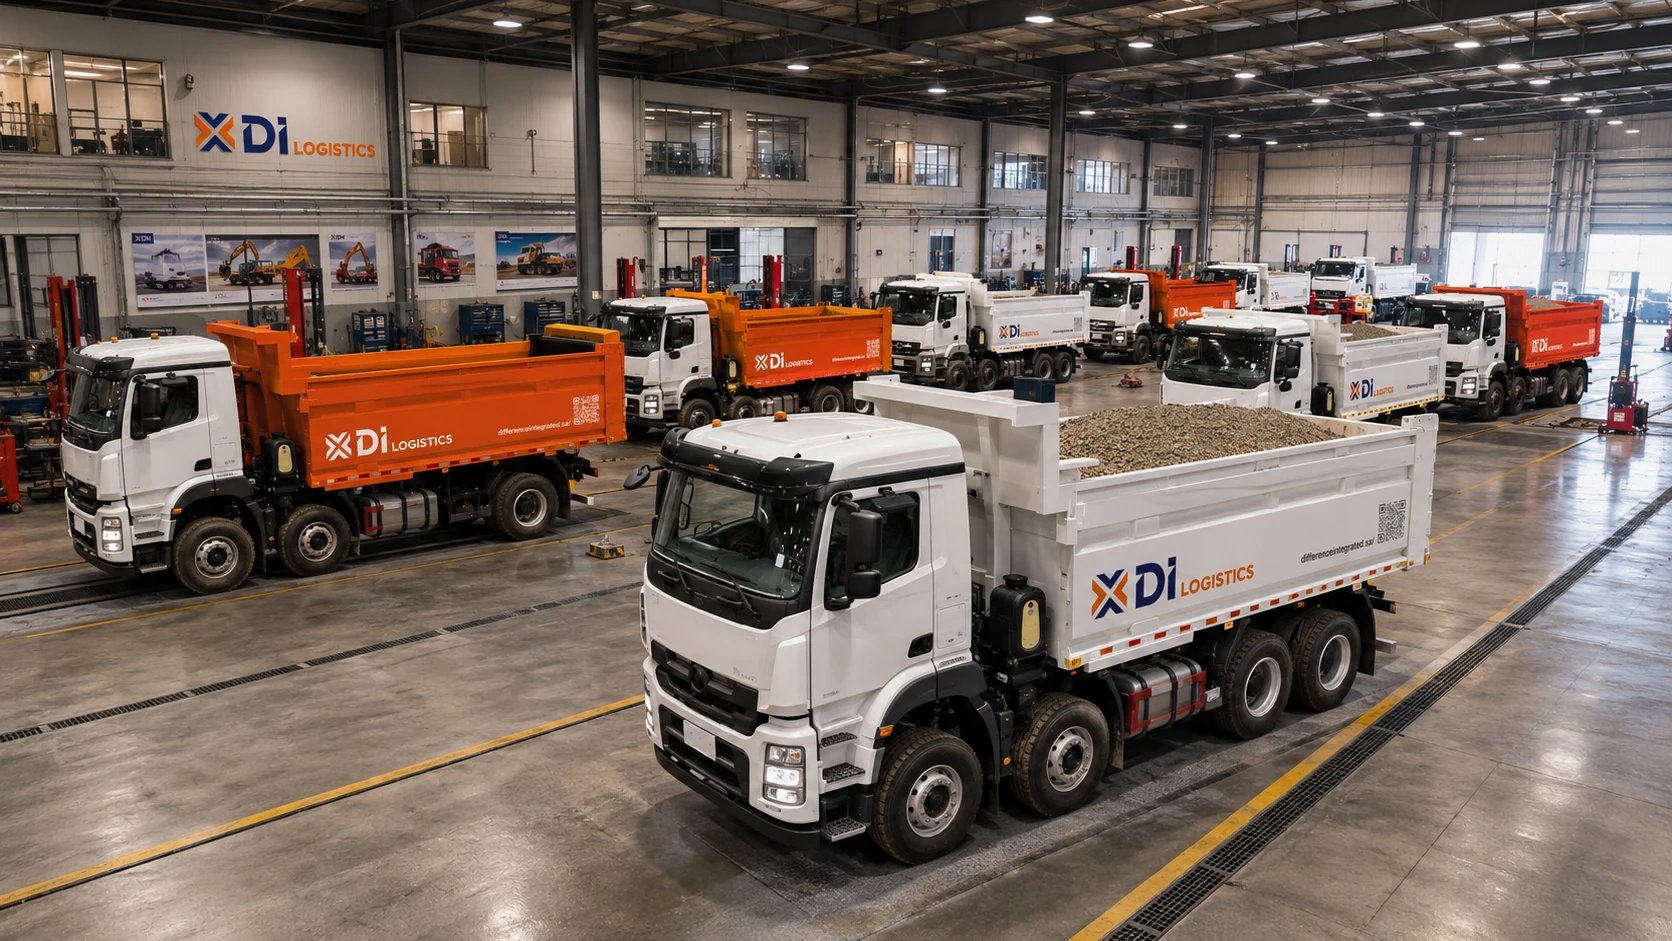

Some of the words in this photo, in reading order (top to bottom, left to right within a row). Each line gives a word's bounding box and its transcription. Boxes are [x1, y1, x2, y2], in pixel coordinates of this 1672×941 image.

[293, 141, 376, 158] LOGISTICS
[392, 434, 453, 452] LOGISTICS
[1181, 564, 1255, 597] LOGISTICS
